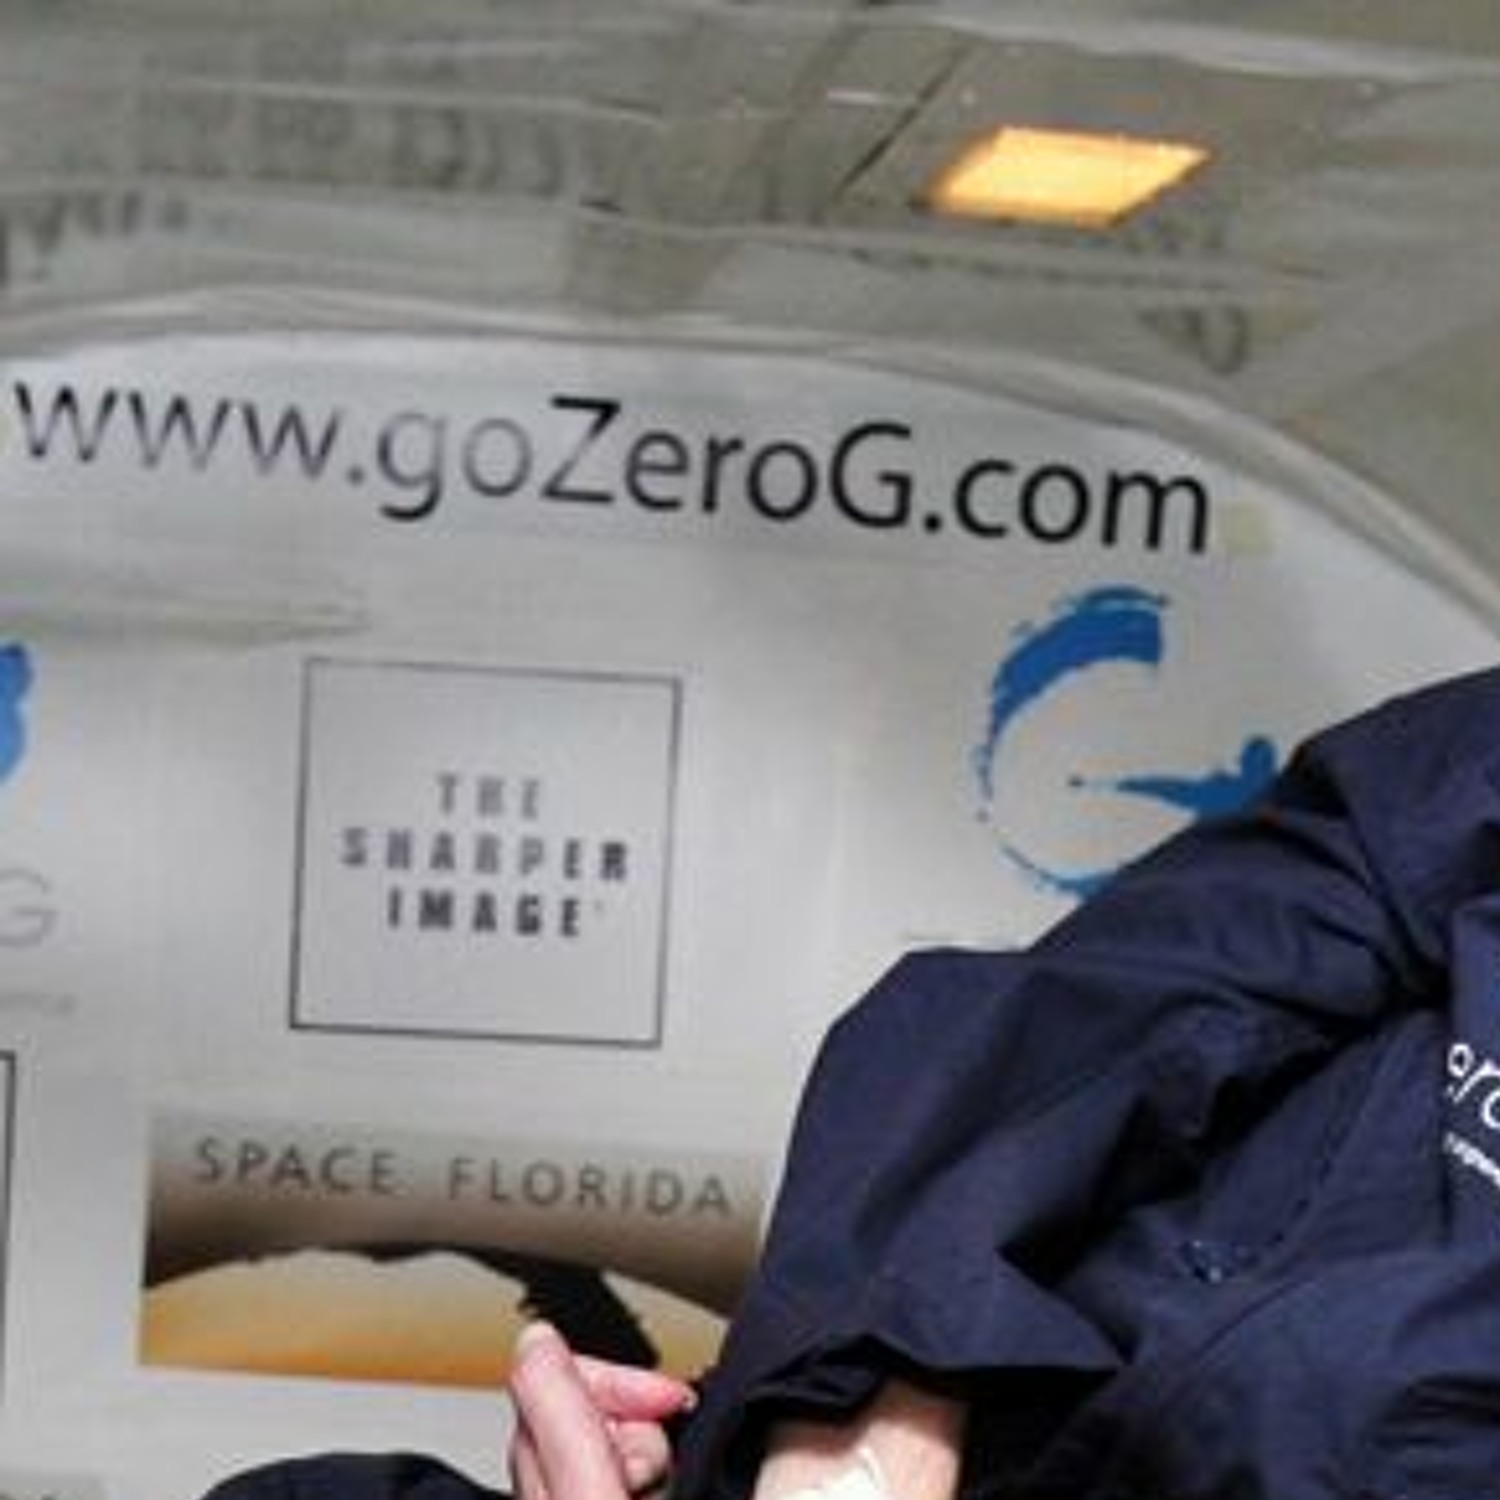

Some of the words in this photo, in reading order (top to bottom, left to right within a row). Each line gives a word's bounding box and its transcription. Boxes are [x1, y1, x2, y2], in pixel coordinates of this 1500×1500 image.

[14, 382, 1211, 556] www.goZeroG.com
[437, 772, 540, 820] THE
[340, 826, 627, 882] SHARPER
[387, 888, 580, 937] IMAGE
[195, 1137, 396, 1196] SPACE
[449, 1155, 733, 1217] FLORIDA
